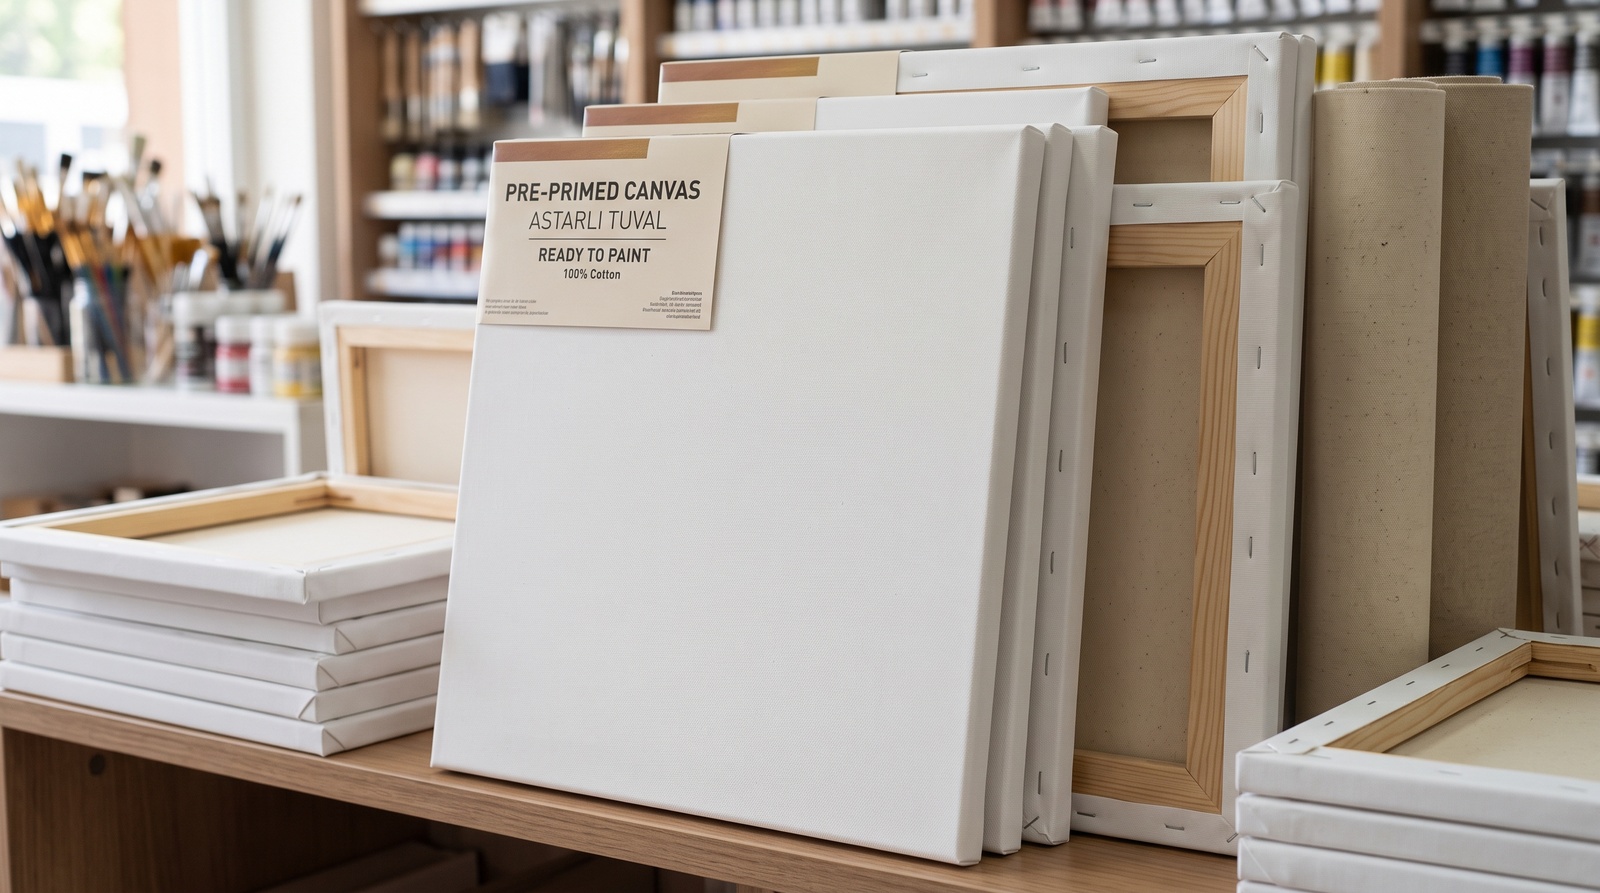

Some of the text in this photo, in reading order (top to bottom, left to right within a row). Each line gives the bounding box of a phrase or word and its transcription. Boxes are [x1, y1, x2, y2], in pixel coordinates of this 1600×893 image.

[505, 179, 701, 202] PRE-PRIMED CANVAS
[528, 210, 667, 230] ASTARLI TUVAL
[538, 247, 652, 263] READY TO PAINT
[563, 268, 621, 280] 100% Cotton
